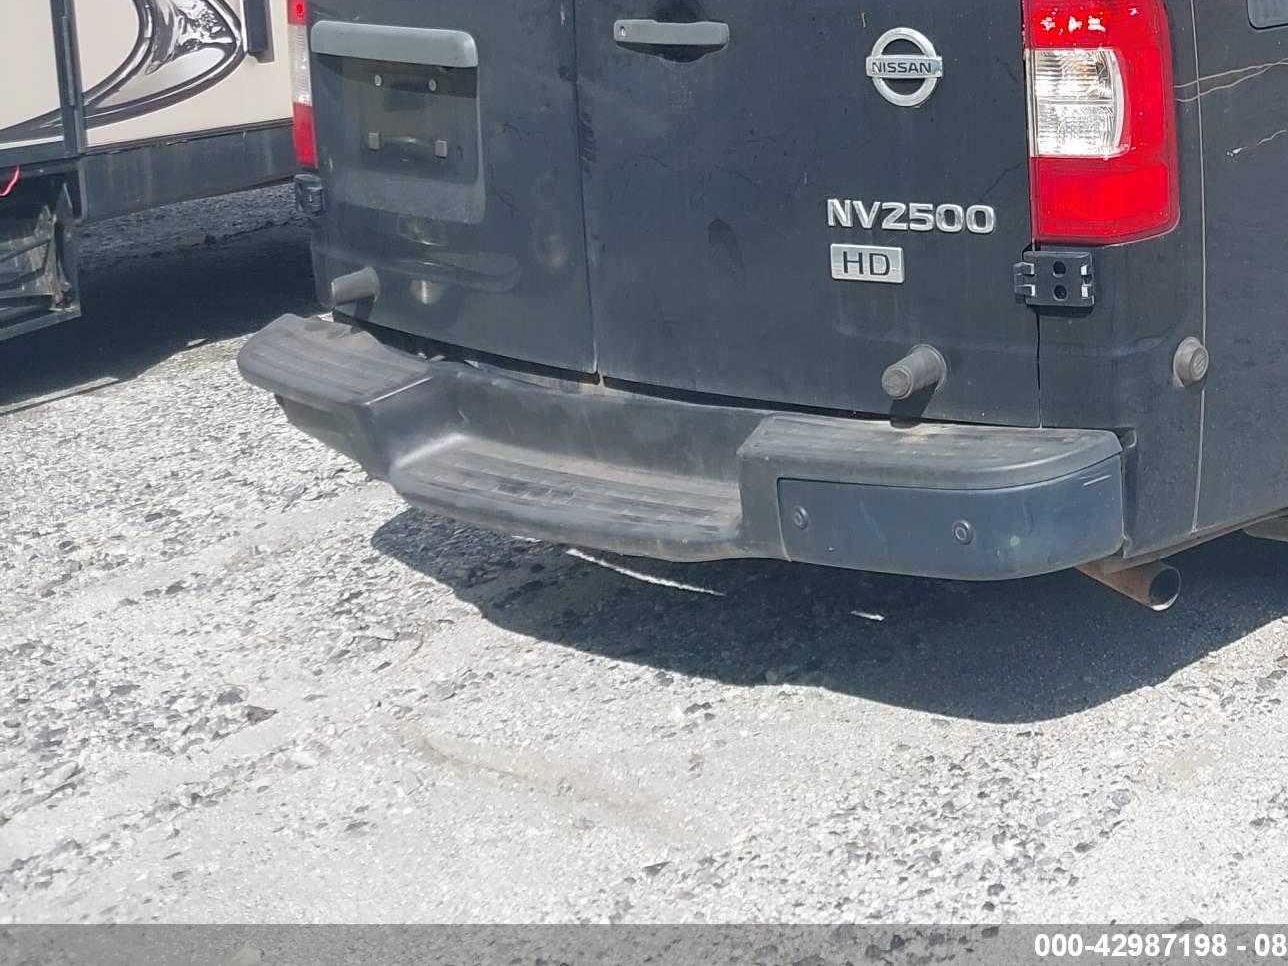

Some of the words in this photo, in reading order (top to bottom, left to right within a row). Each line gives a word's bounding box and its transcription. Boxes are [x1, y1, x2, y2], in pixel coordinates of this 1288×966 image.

[872, 61, 932, 74] NISSAN
[826, 197, 996, 234] NV2500
[842, 250, 891, 276] HD
